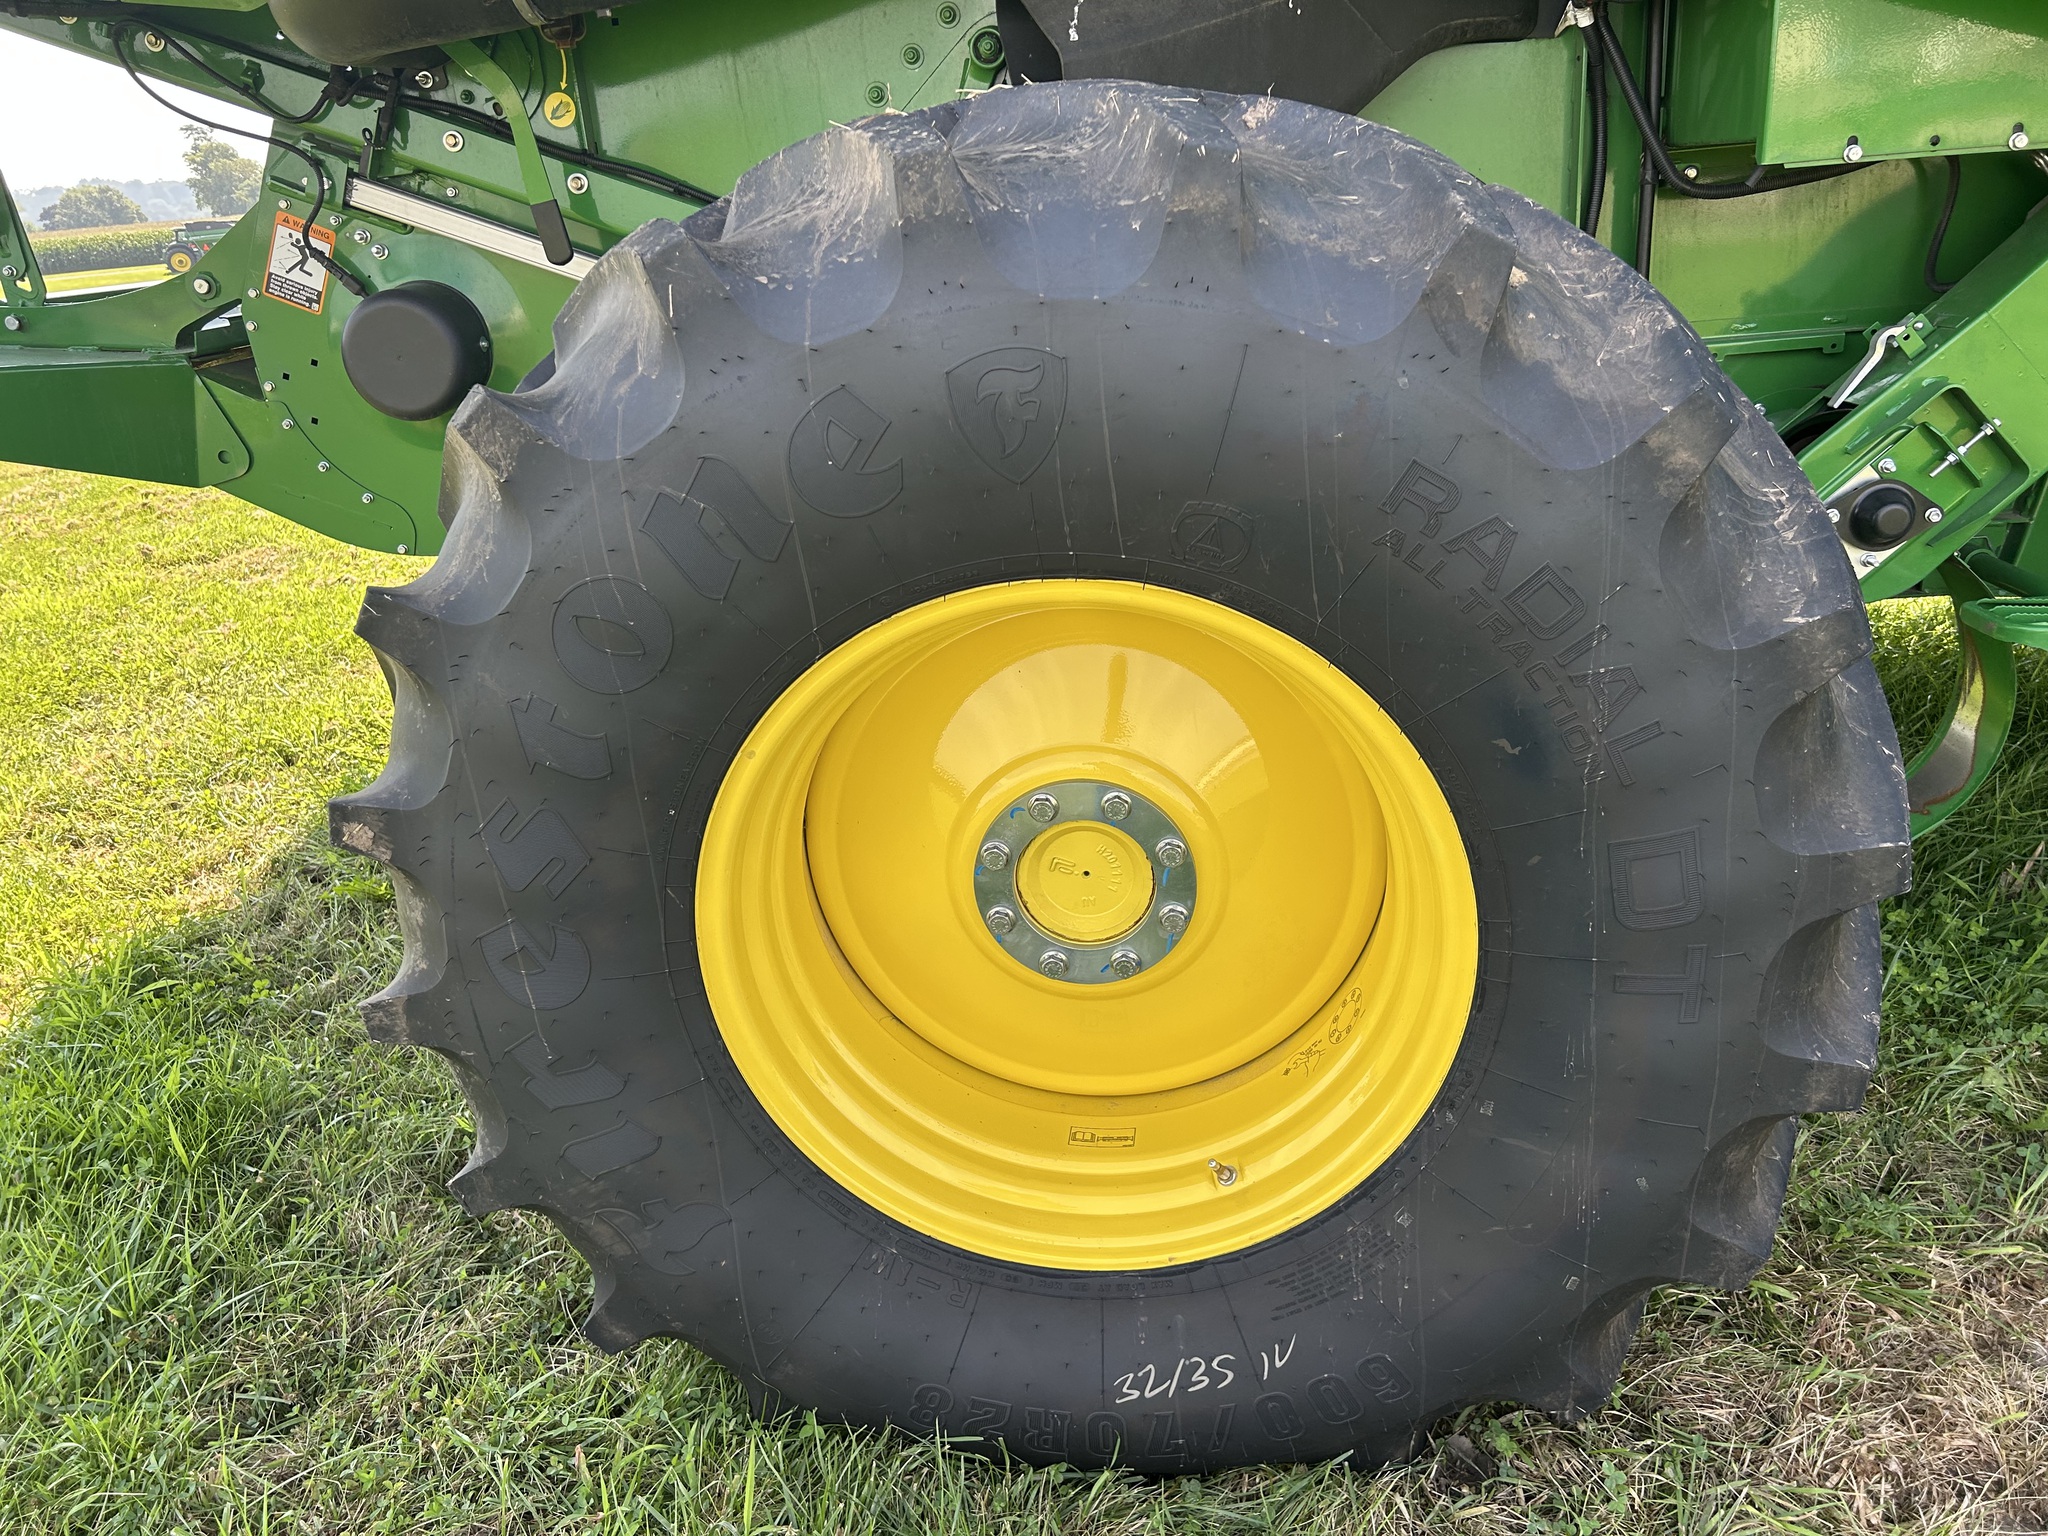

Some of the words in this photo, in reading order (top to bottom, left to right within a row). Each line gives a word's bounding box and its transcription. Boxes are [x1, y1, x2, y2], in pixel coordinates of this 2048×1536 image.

[292, 219, 330, 240] WANING
[1371, 527, 1447, 591] ALL
[1459, 584, 1610, 786] TRACTION
[1377, 456, 1666, 787] RADIAL
[1606, 825, 1709, 1026] DT
[911, 1352, 1413, 1459] 600/70R28
[1113, 1353, 1236, 1404] 32/35
